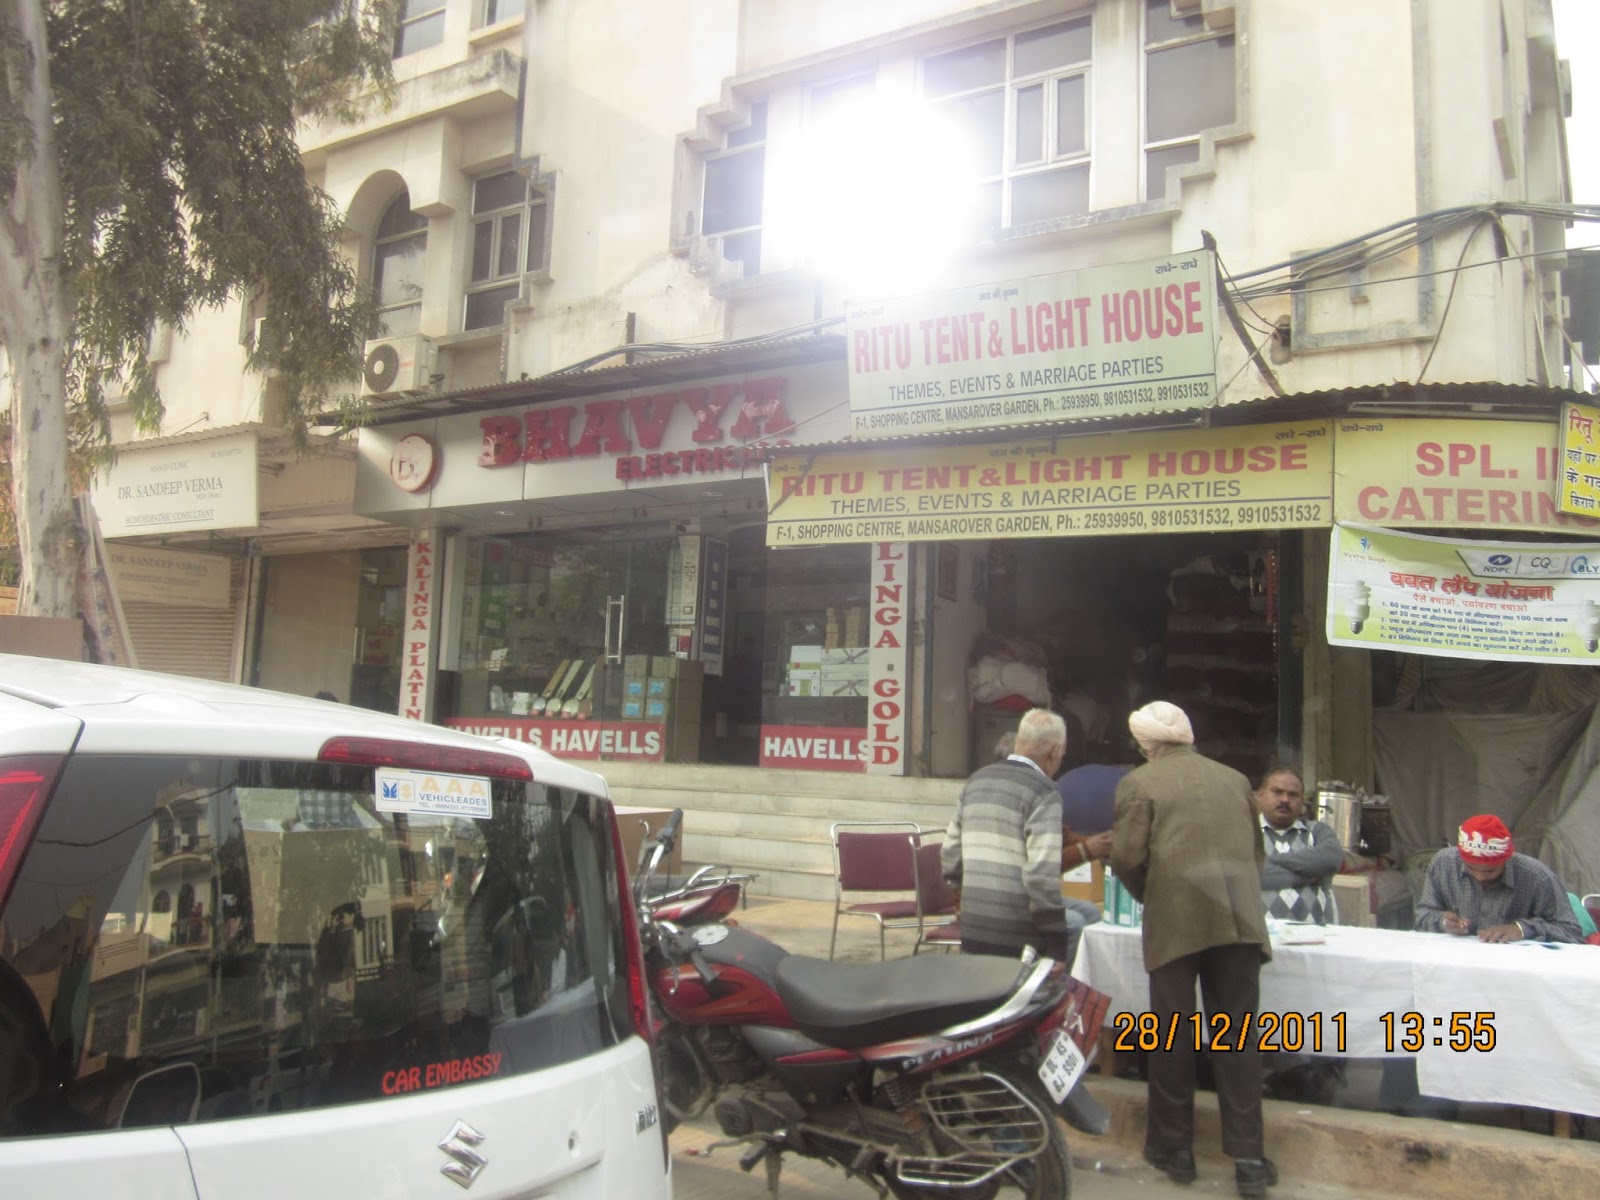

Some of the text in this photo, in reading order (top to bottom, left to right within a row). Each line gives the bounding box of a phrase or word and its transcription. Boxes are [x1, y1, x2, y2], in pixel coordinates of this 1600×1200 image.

[854, 321, 912, 374] RITU
[920, 312, 986, 366] TENT
[1010, 297, 1091, 356] LIGHT
[1102, 280, 1204, 345] HOUSE
[888, 356, 1164, 402] THEMES, EVENTS & MARRIAGE PARTIES
[477, 376, 796, 469] BHAVYA
[870, 412, 909, 430] SHOPPING
[910, 408, 944, 426] CENTRE,
[945, 402, 1002, 424] MANSAROVER
[1004, 399, 1042, 419] GARDEN,
[1157, 382, 1210, 400] 9910531532
[781, 472, 864, 498] RITU
[1148, 444, 1308, 478] HOUSE
[1416, 442, 1518, 479] SPL.
[1566, 468, 1579, 484] के
[118, 486, 134, 500] DR.
[136, 480, 183, 498] SANDEEP
[184, 476, 224, 493] VERMA
[830, 480, 1241, 516] THEMES, EVENTS & MARRIAGE PARTIES
[1357, 485, 1599, 528] CATERIN
[776, 504, 1321, 542] F-1, SHOPPING CENTRE, MANSAROVER GARDEN, Ph.: 25939950, 9810531532, 9910531532
[411, 542, 432, 630] KALINGA
[1389, 572, 1438, 592] बचत
[1484, 580, 1554, 601] योजना
[1483, 566, 1510, 574] NDPL
[871, 678, 900, 765] GOLD
[550, 728, 660, 755] HAVELLS
[764, 736, 872, 762] HAVELLS
[418, 793, 488, 806] VEHICLEADES
[902, 1032, 994, 1070] PLATINA
[382, 1053, 503, 1095] CAR EMBASSY
